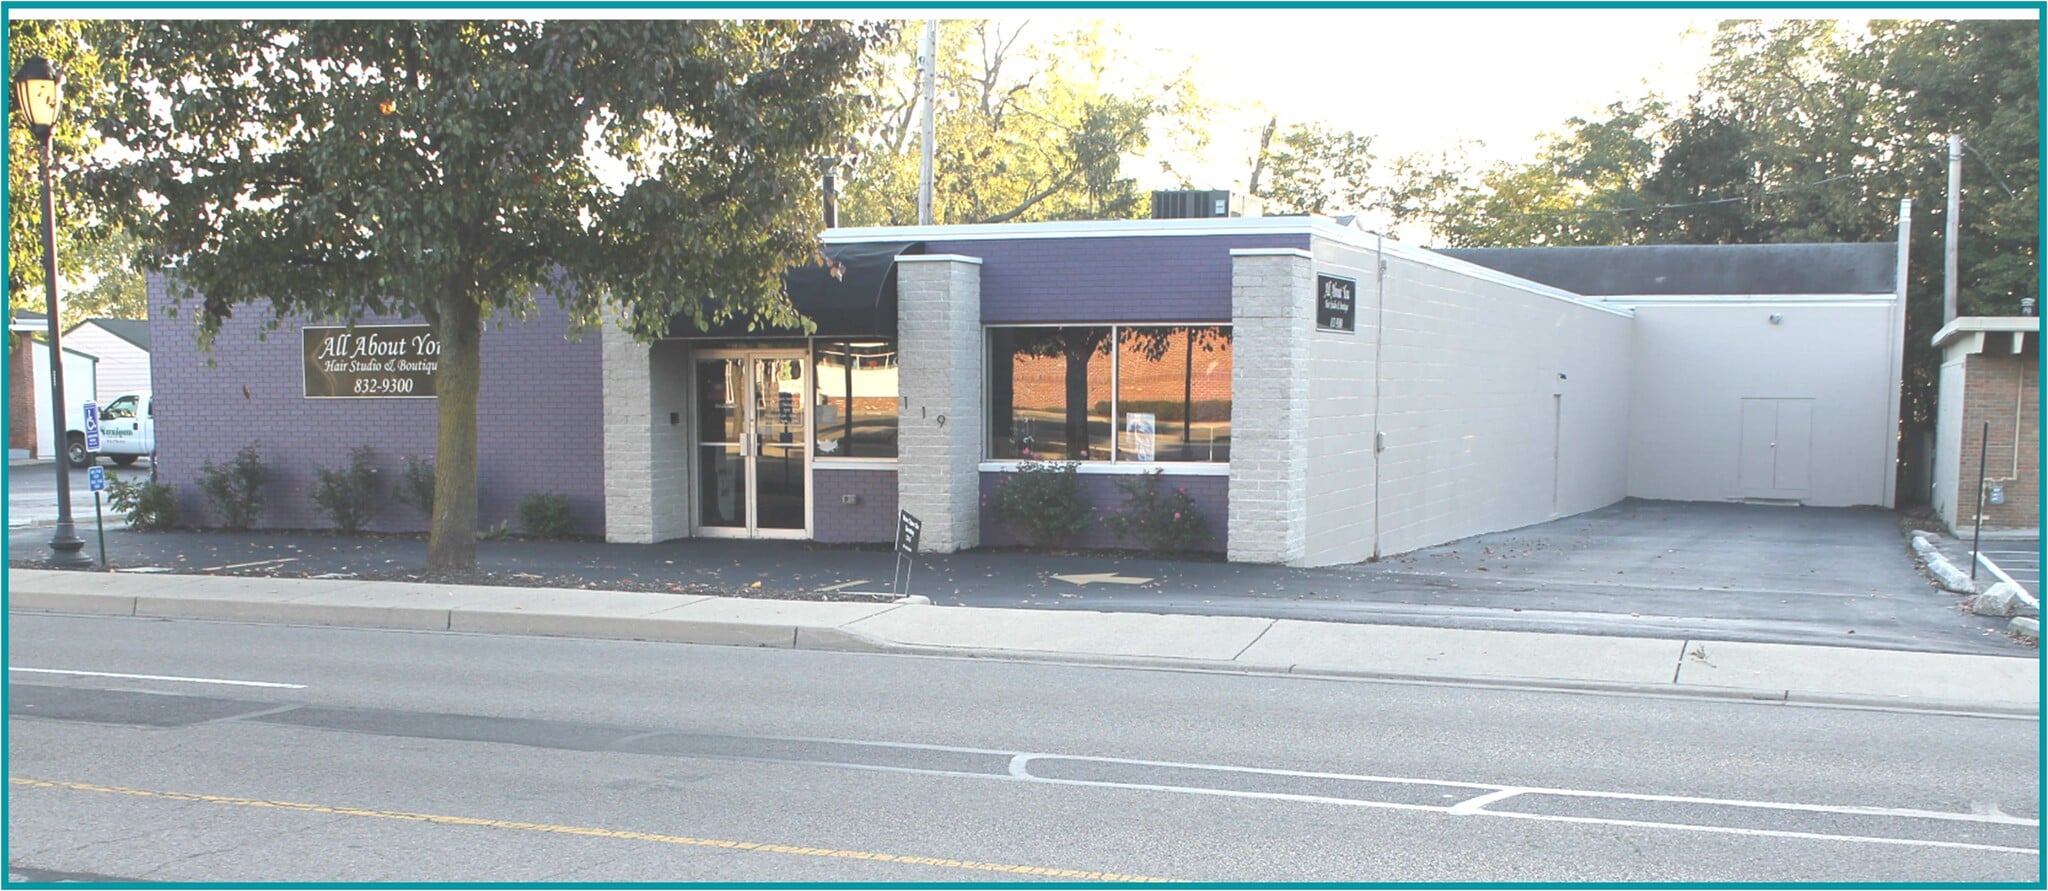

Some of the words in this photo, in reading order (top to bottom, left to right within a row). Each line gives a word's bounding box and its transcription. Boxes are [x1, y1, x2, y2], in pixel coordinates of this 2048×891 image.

[318, 333, 351, 359] All
[350, 333, 407, 359] About
[324, 359, 347, 373] Hair
[348, 359, 382, 372] Studio
[384, 359, 396, 372] &
[397, 359, 438, 376] Boutiqu
[353, 378, 414, 394] 832-9300
